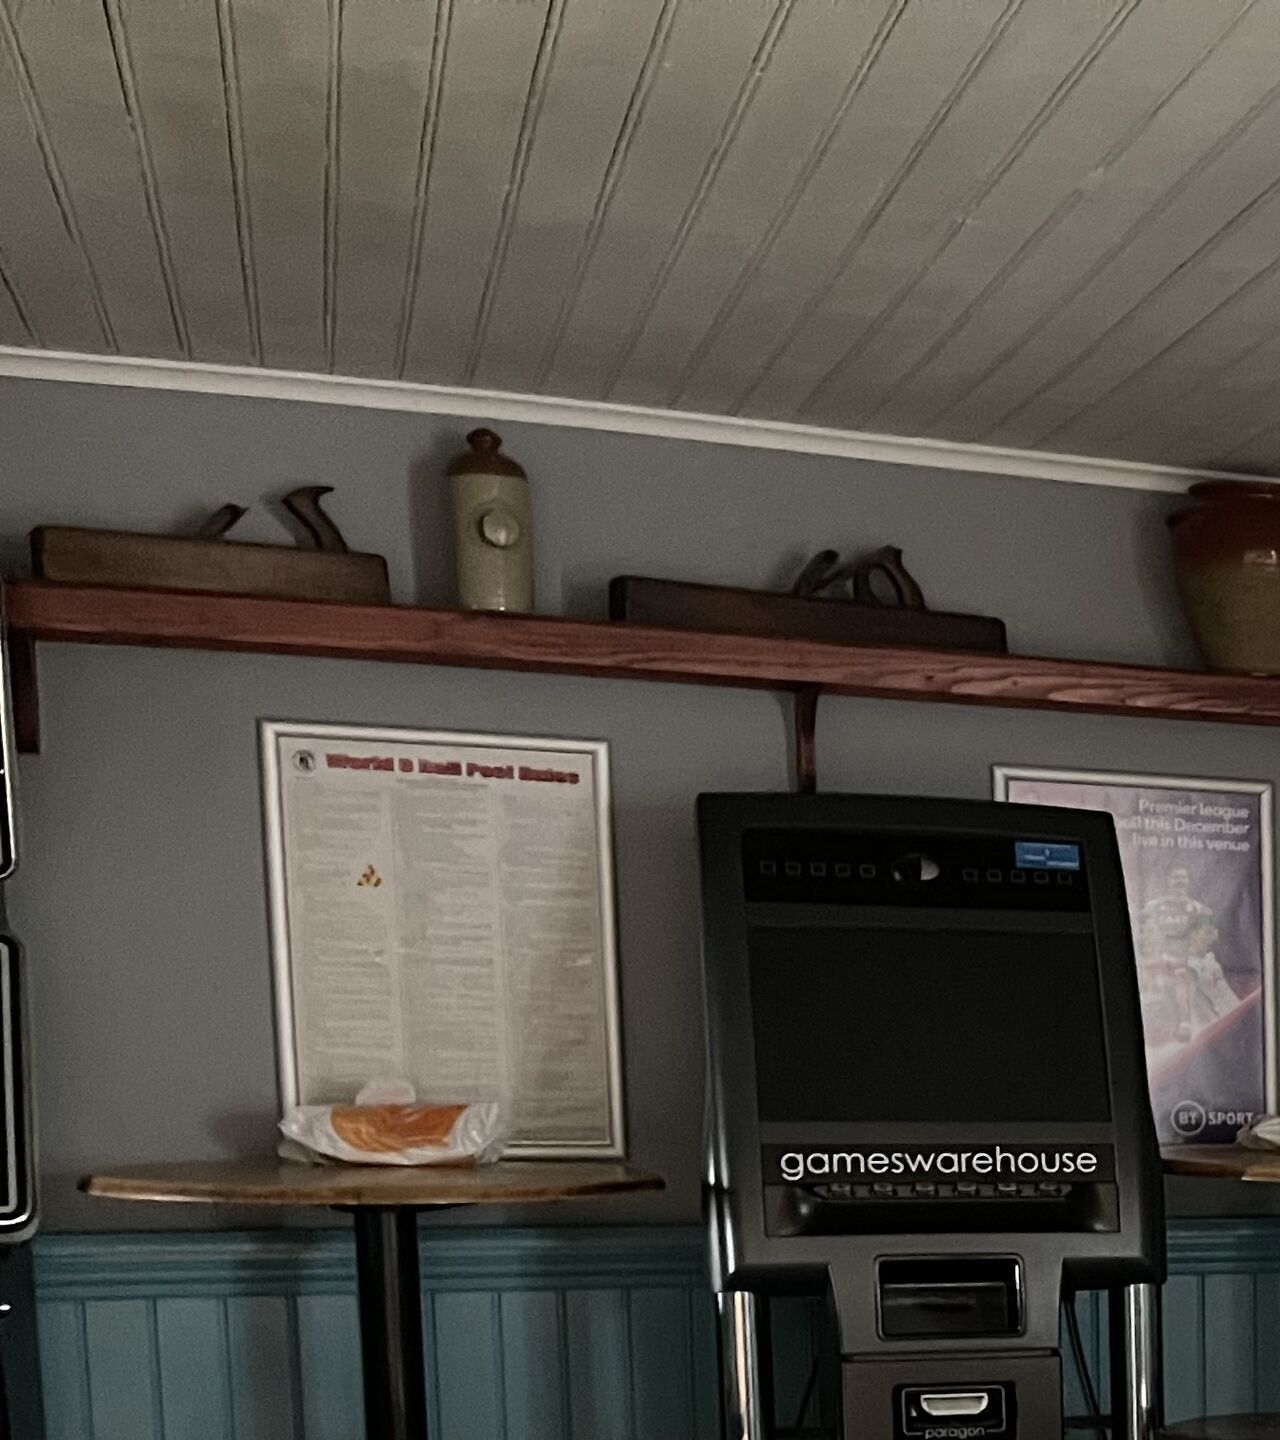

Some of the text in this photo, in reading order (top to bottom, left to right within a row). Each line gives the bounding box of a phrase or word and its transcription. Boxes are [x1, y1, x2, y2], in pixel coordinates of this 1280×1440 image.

[466, 762, 514, 779] Pool
[1138, 798, 1250, 819] Premier league
[1174, 818, 1250, 834] December
[1178, 835, 1203, 850] this
[1204, 839, 1250, 852] venue
[1178, 1111, 1254, 1126] BT SPORT
[780, 1146, 1098, 1181] gameswarehouse
[924, 1426, 985, 1440] paragon
